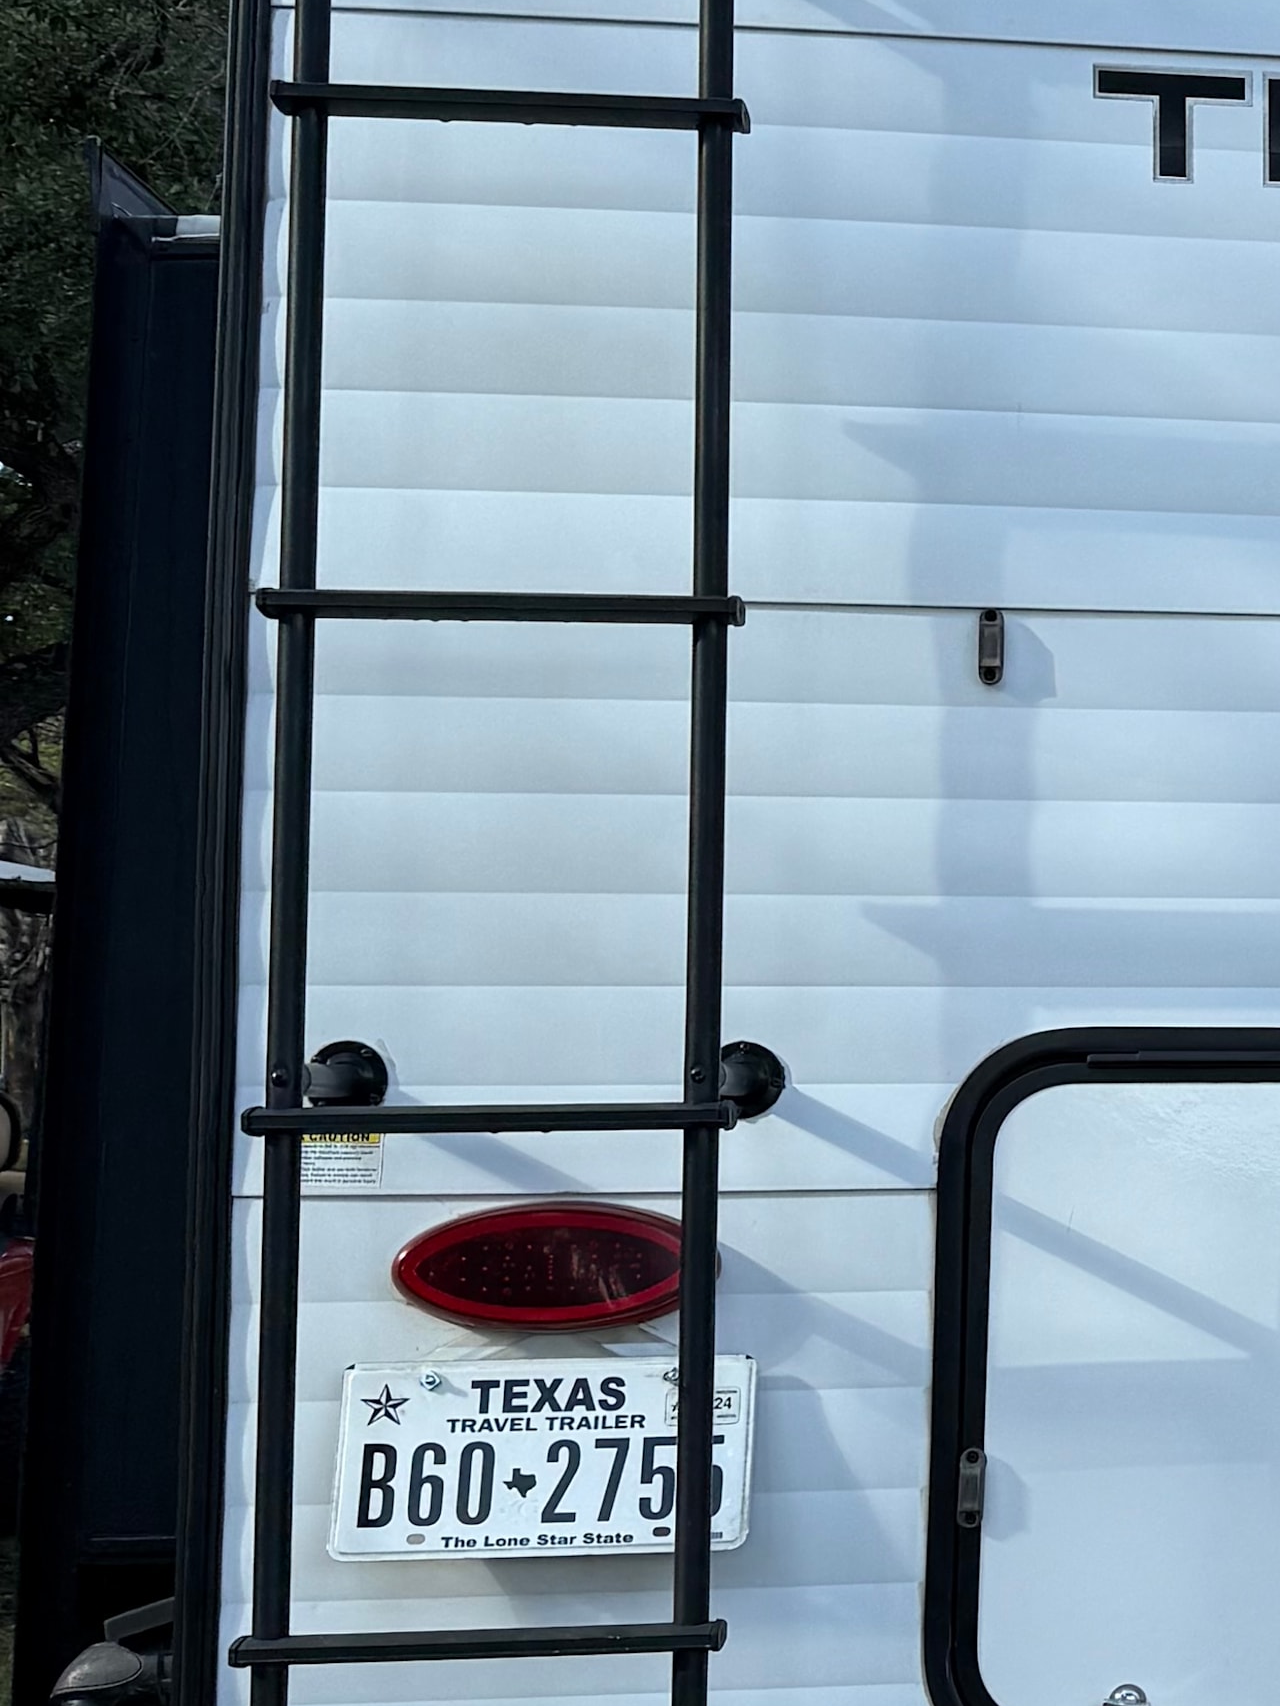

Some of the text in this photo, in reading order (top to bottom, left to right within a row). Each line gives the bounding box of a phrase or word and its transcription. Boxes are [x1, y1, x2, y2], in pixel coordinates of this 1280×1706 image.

[471, 1377, 626, 1414] TEXAS
[713, 1396, 732, 1410] 24
[446, 1414, 646, 1434] TRAVEL TRAILER
[356, 1441, 497, 1529] B60
[441, 1532, 634, 1548] The Lone Star State
